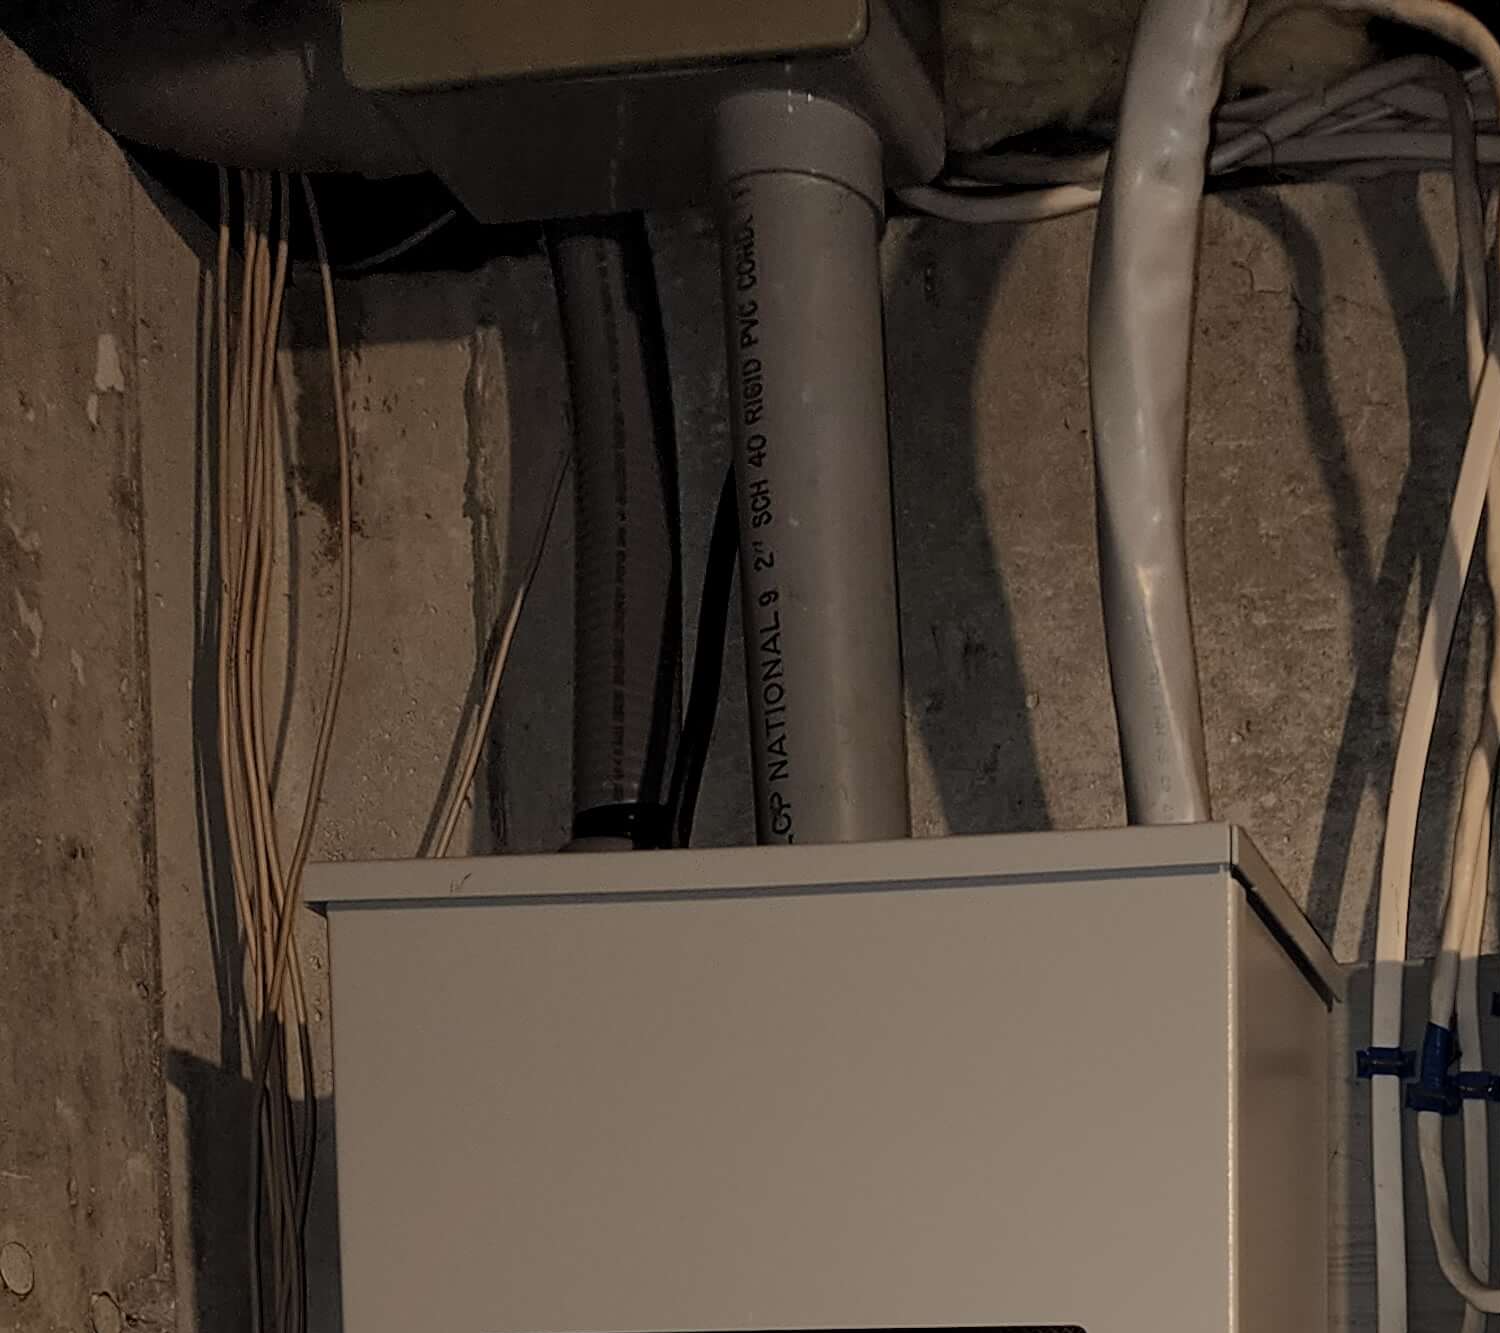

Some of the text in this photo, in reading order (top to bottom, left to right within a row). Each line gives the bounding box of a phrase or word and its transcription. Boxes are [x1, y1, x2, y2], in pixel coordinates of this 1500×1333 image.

[737, 300, 760, 350] PVC
[742, 357, 764, 426] RIGID
[747, 433, 768, 468] 40
[749, 478, 773, 529] SCH
[759, 610, 790, 782] NATIONAL
[769, 791, 795, 845] CP
